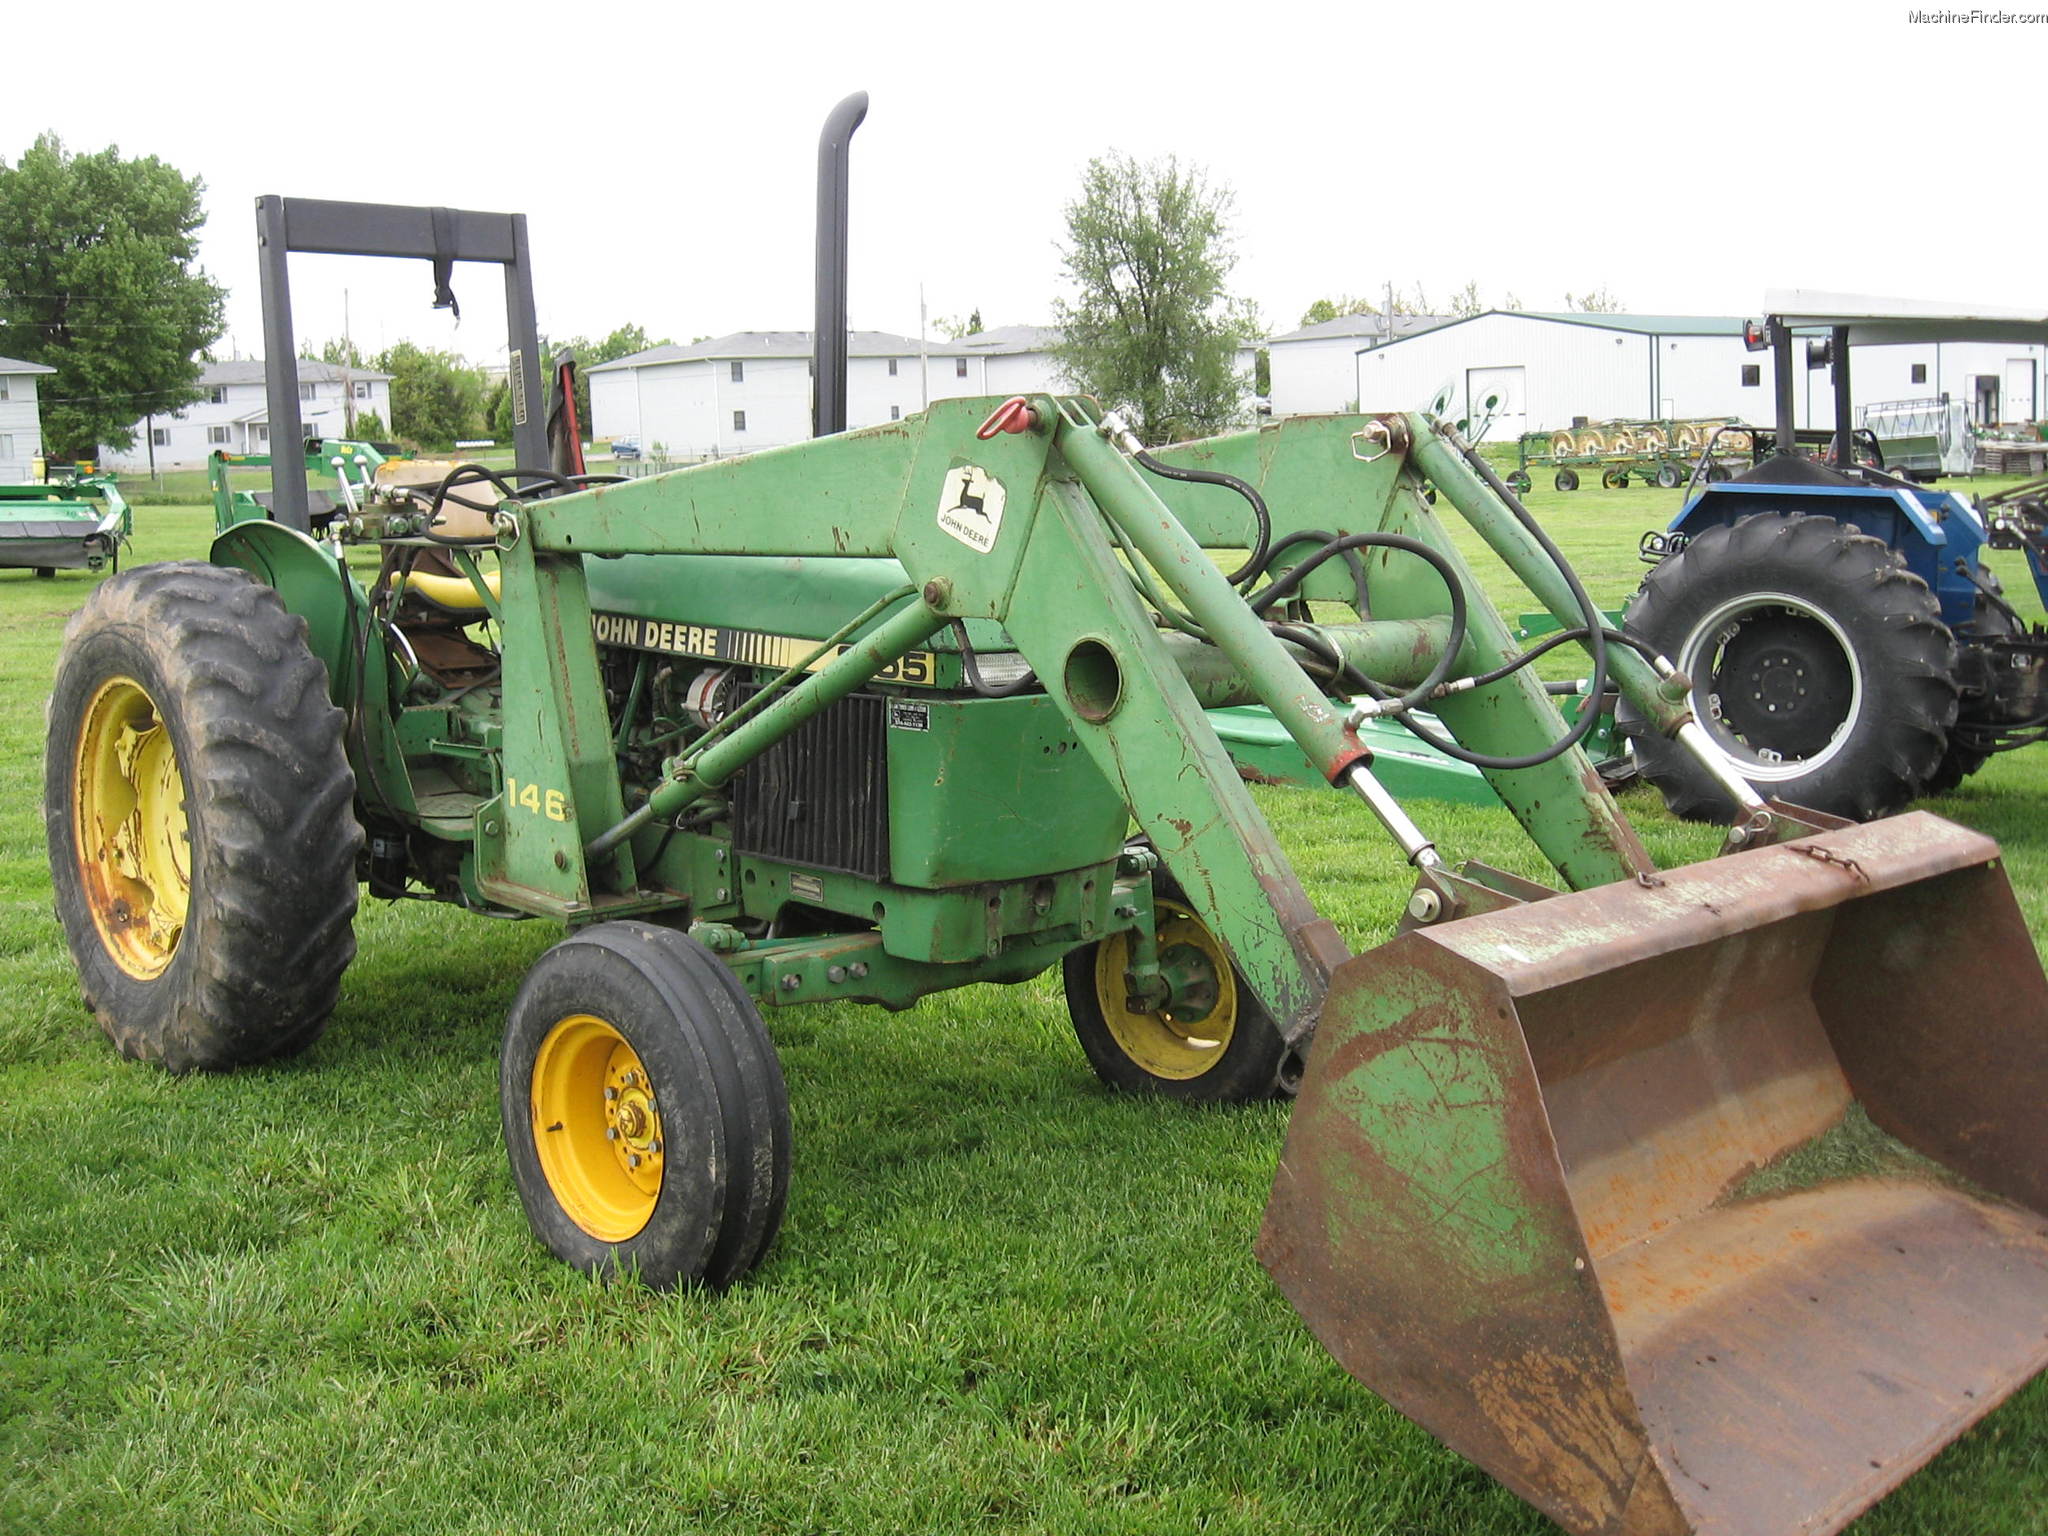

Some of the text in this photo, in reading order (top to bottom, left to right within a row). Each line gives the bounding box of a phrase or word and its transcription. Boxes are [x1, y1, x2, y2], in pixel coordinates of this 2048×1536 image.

[940, 513, 990, 547] JOHN DEERE
[644, 620, 718, 657] DEERE
[506, 777, 566, 822] 146
